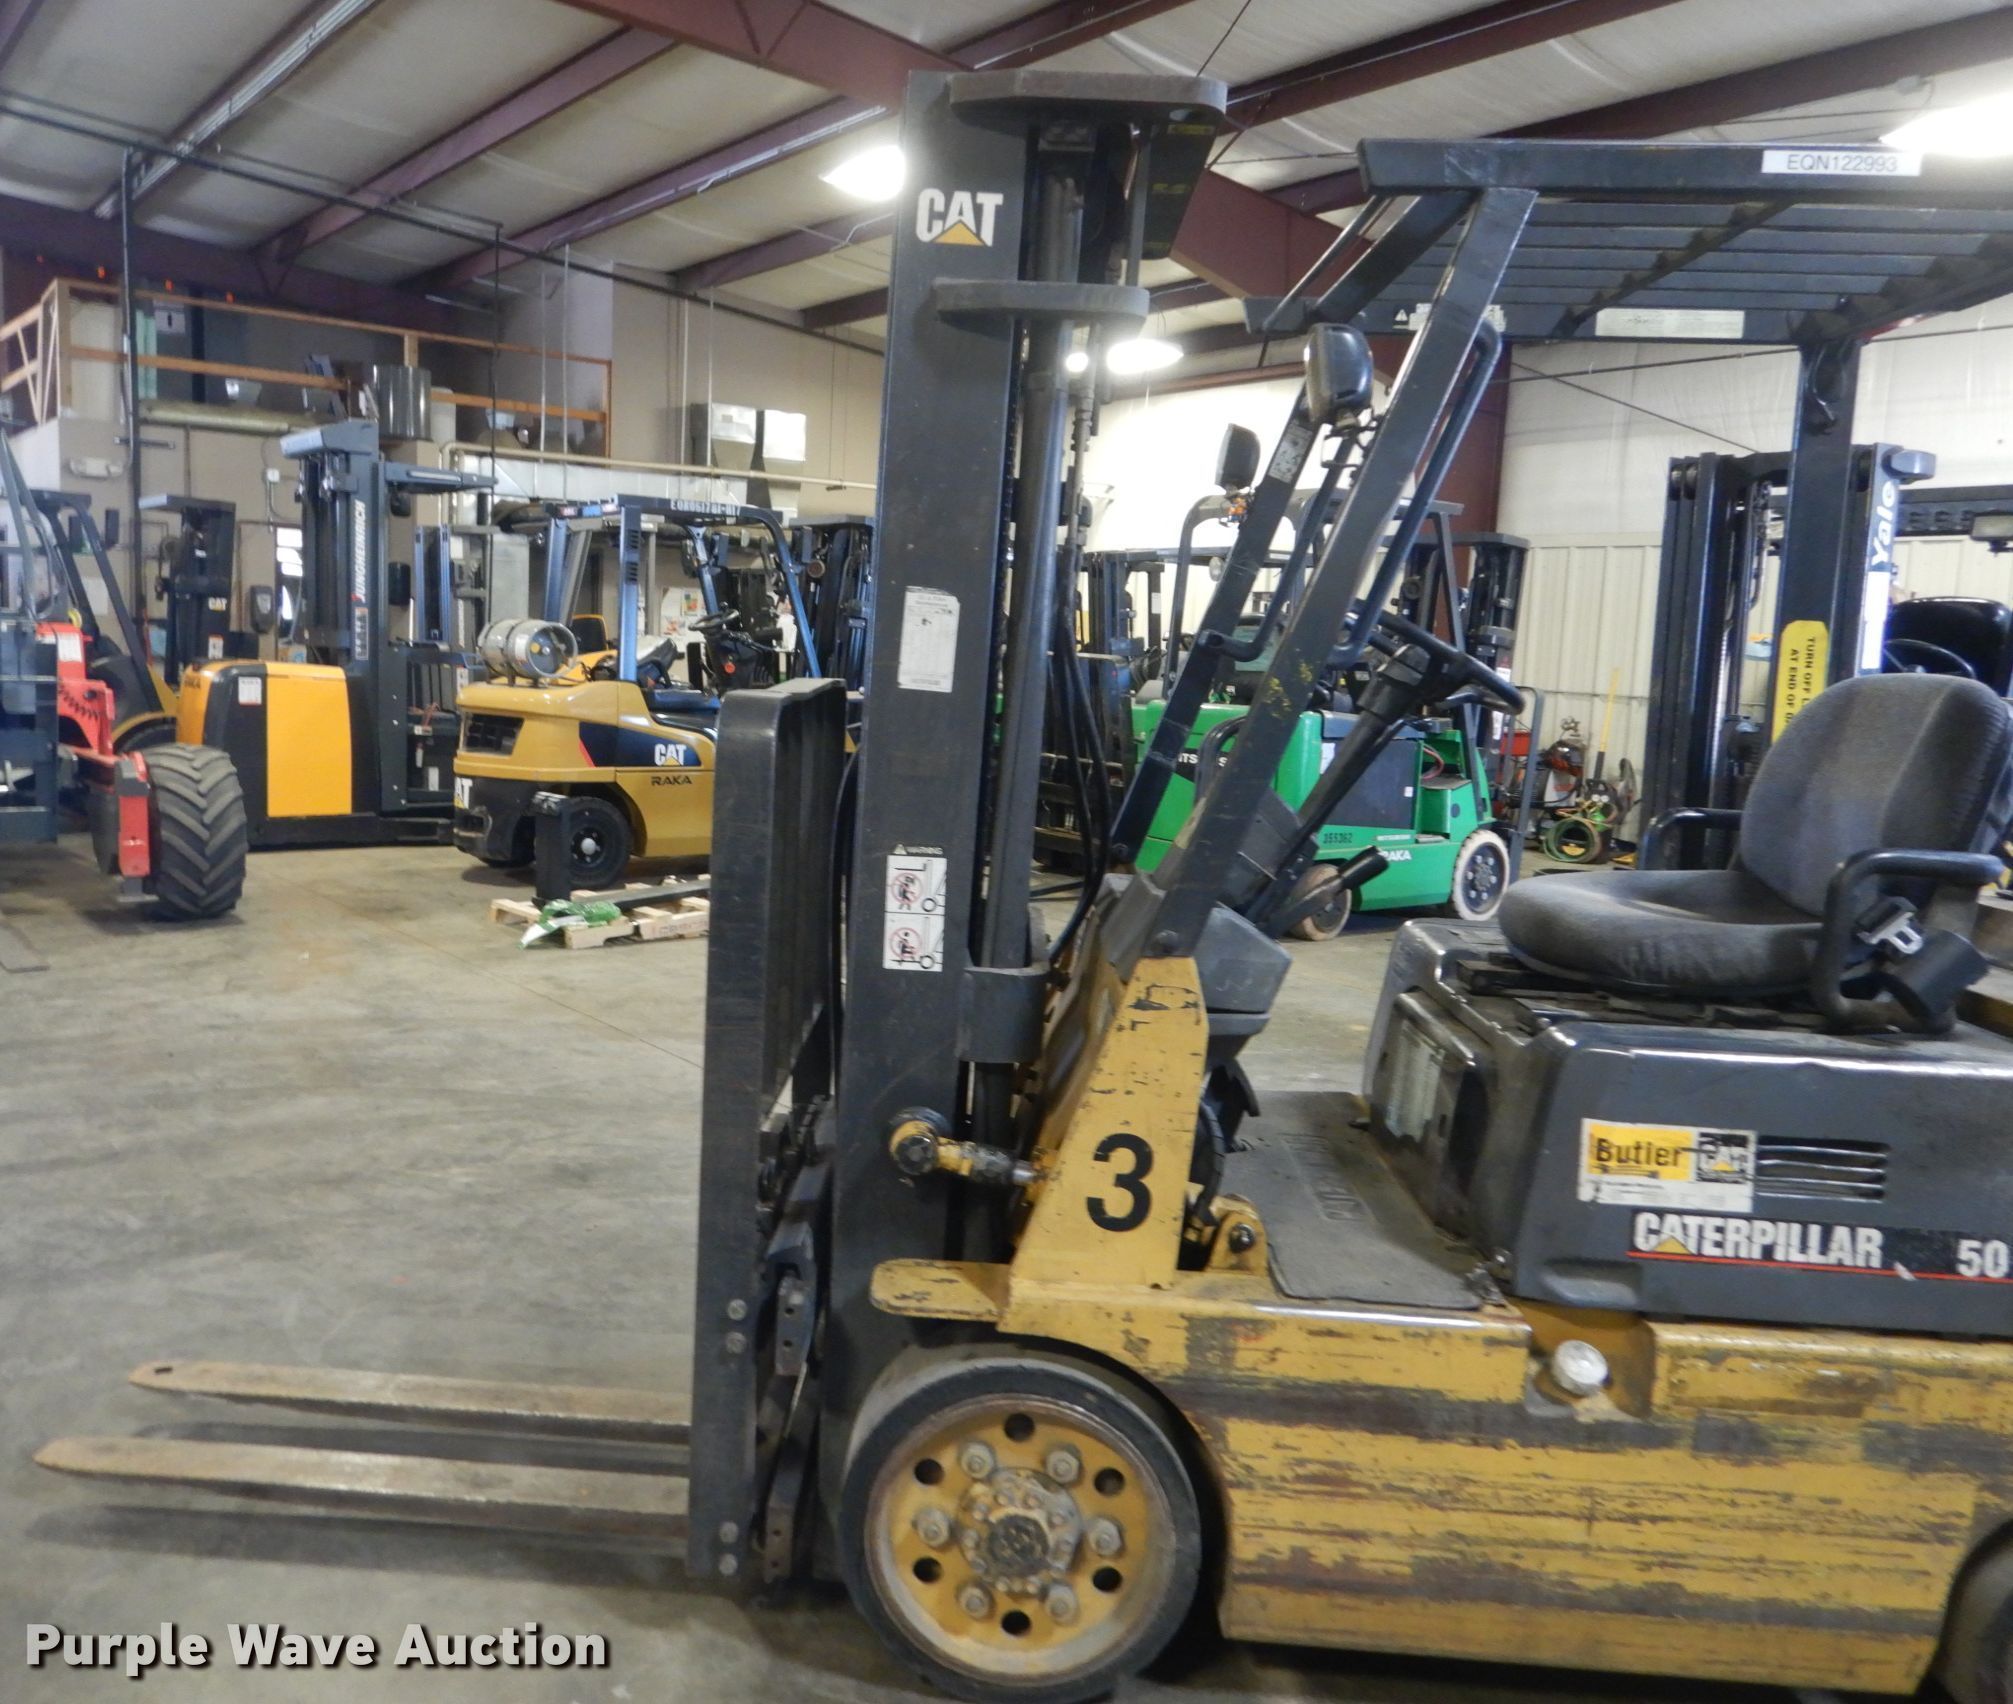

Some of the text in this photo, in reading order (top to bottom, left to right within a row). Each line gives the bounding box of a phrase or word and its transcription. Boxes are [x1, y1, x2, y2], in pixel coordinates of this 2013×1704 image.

[1786, 154, 1898, 172] EQN122993
[916, 188, 1004, 247] CAT
[1871, 481, 1896, 565] Yale
[354, 499, 366, 603] JUNGHEINRICH
[208, 597, 227, 611] CAT
[1789, 648, 1799, 662] AT
[1804, 636, 1816, 669] TURN
[1788, 666, 1798, 690] END
[1802, 672, 1812, 693] OFF
[1786, 693, 1796, 708] OF
[654, 743, 687, 766] CAT
[455, 776, 473, 809] AT
[651, 775, 693, 787] RAKA
[1086, 1132, 1154, 1232] 3
[1633, 1210, 2010, 1279] CATERPILLAR 50
